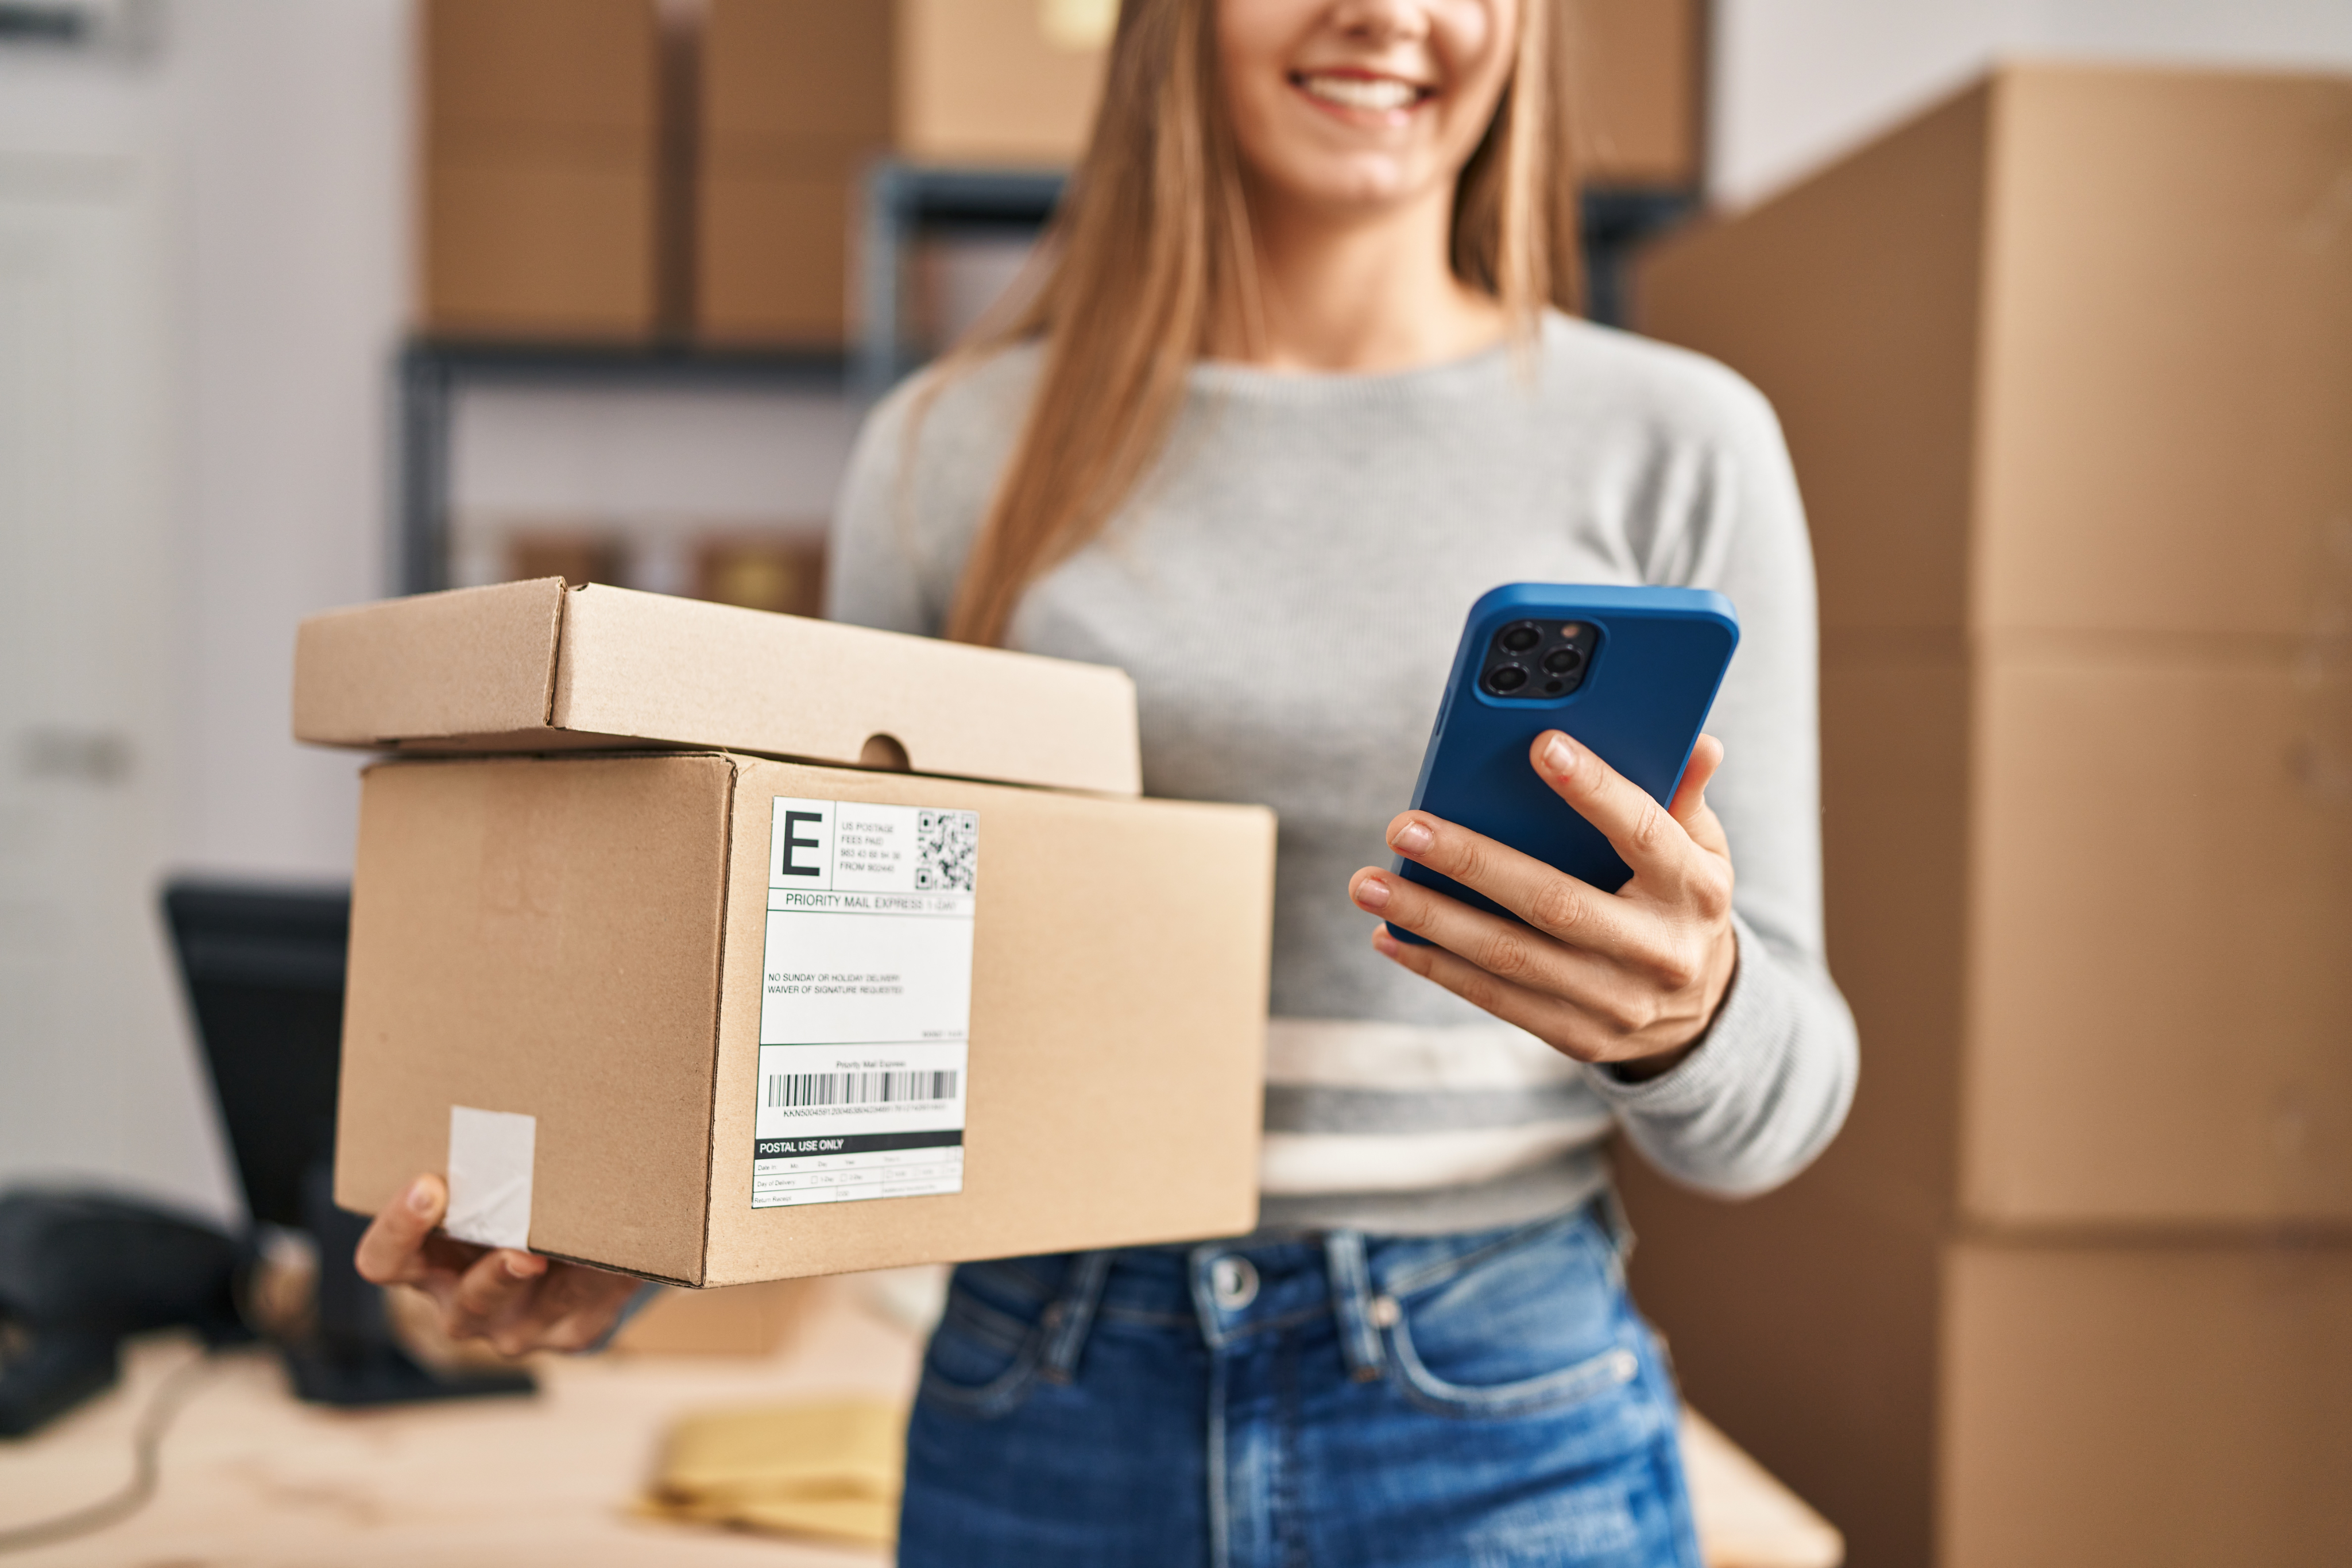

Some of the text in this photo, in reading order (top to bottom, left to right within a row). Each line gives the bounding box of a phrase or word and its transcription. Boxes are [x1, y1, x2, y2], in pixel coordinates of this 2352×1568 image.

[842, 822, 893, 833] US POSTAGE
[782, 810, 822, 876] E
[841, 834, 862, 844] FEES
[840, 861, 865, 872] FROM
[786, 893, 841, 907] PRIORITY
[844, 896, 870, 908] MAIL
[875, 897, 923, 911] EXPRESS
[768, 973, 781, 982] NO
[783, 973, 815, 982] SUNDAY
[818, 974, 830, 982] OR
[831, 974, 864, 982] HOLIDAY
[768, 985, 799, 994] WAIVER
[802, 985, 813, 994] OF
[814, 986, 857, 994] SIGNATURE
[760, 1139, 844, 1153] POSTAL USE ONLY
[772, 1194, 792, 1203] Receipt
